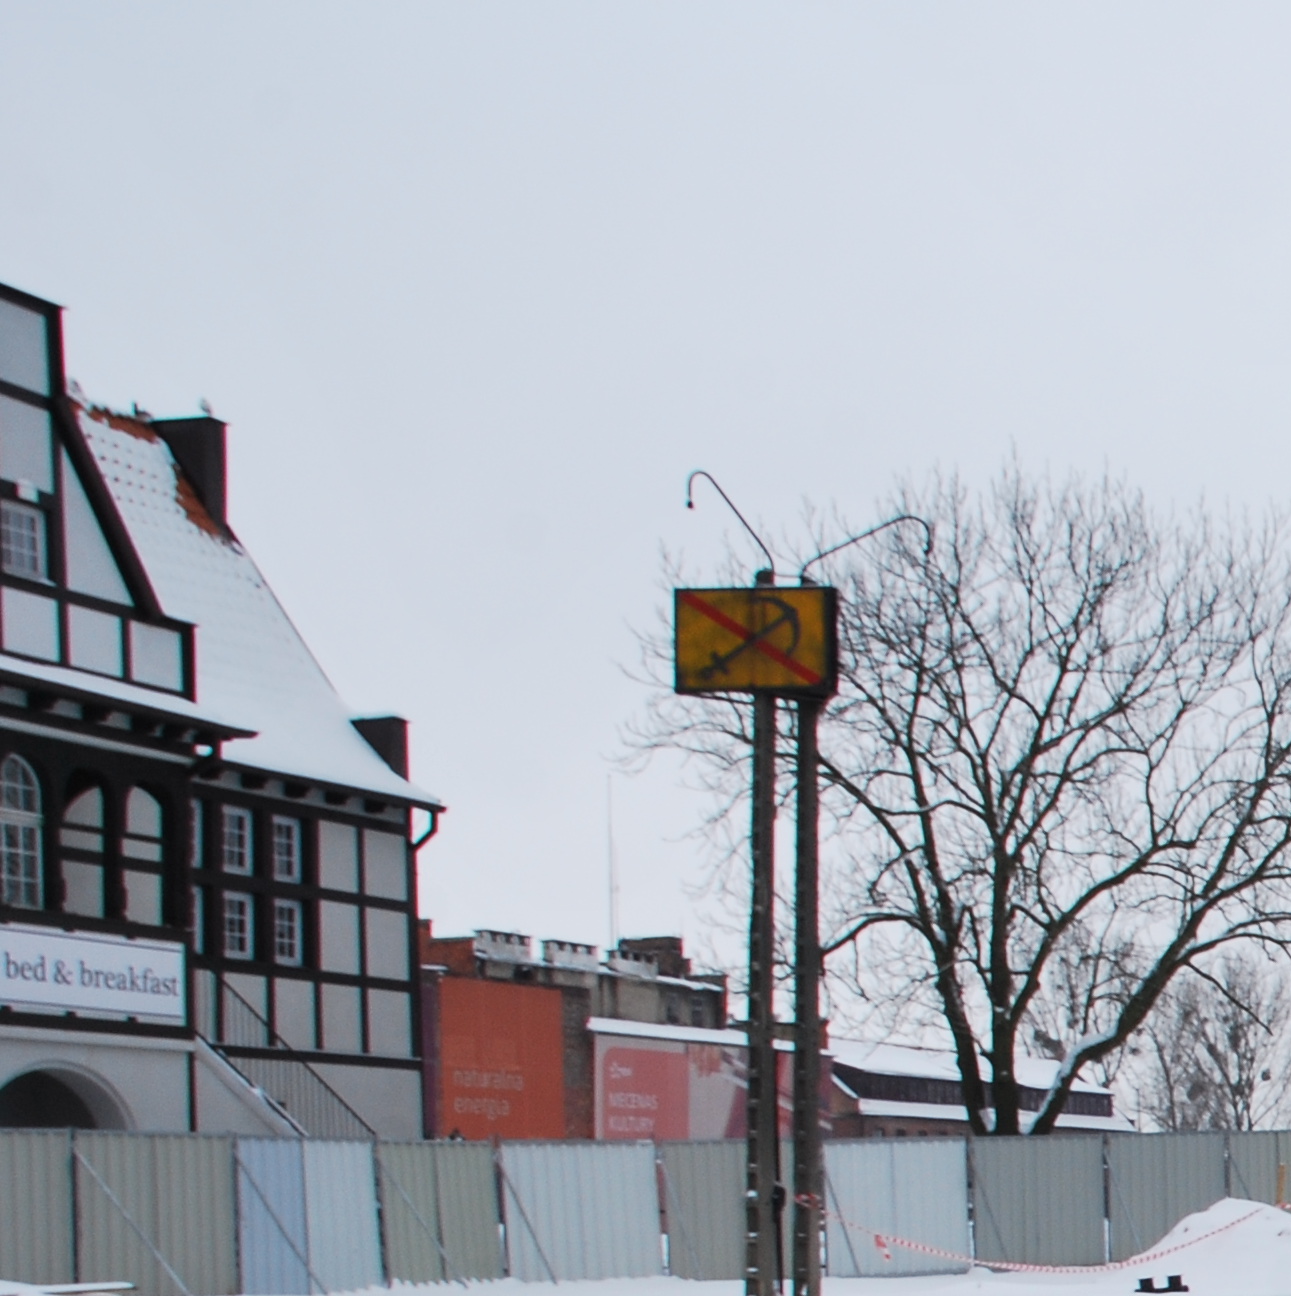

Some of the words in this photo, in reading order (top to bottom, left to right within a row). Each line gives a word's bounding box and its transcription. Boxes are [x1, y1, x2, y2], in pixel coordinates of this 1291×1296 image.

[5, 952, 47, 982] bed
[54, 959, 73, 986] &
[79, 960, 179, 996] breakfast
[453, 1069, 524, 1091] naturalna
[454, 1097, 509, 1120] energia
